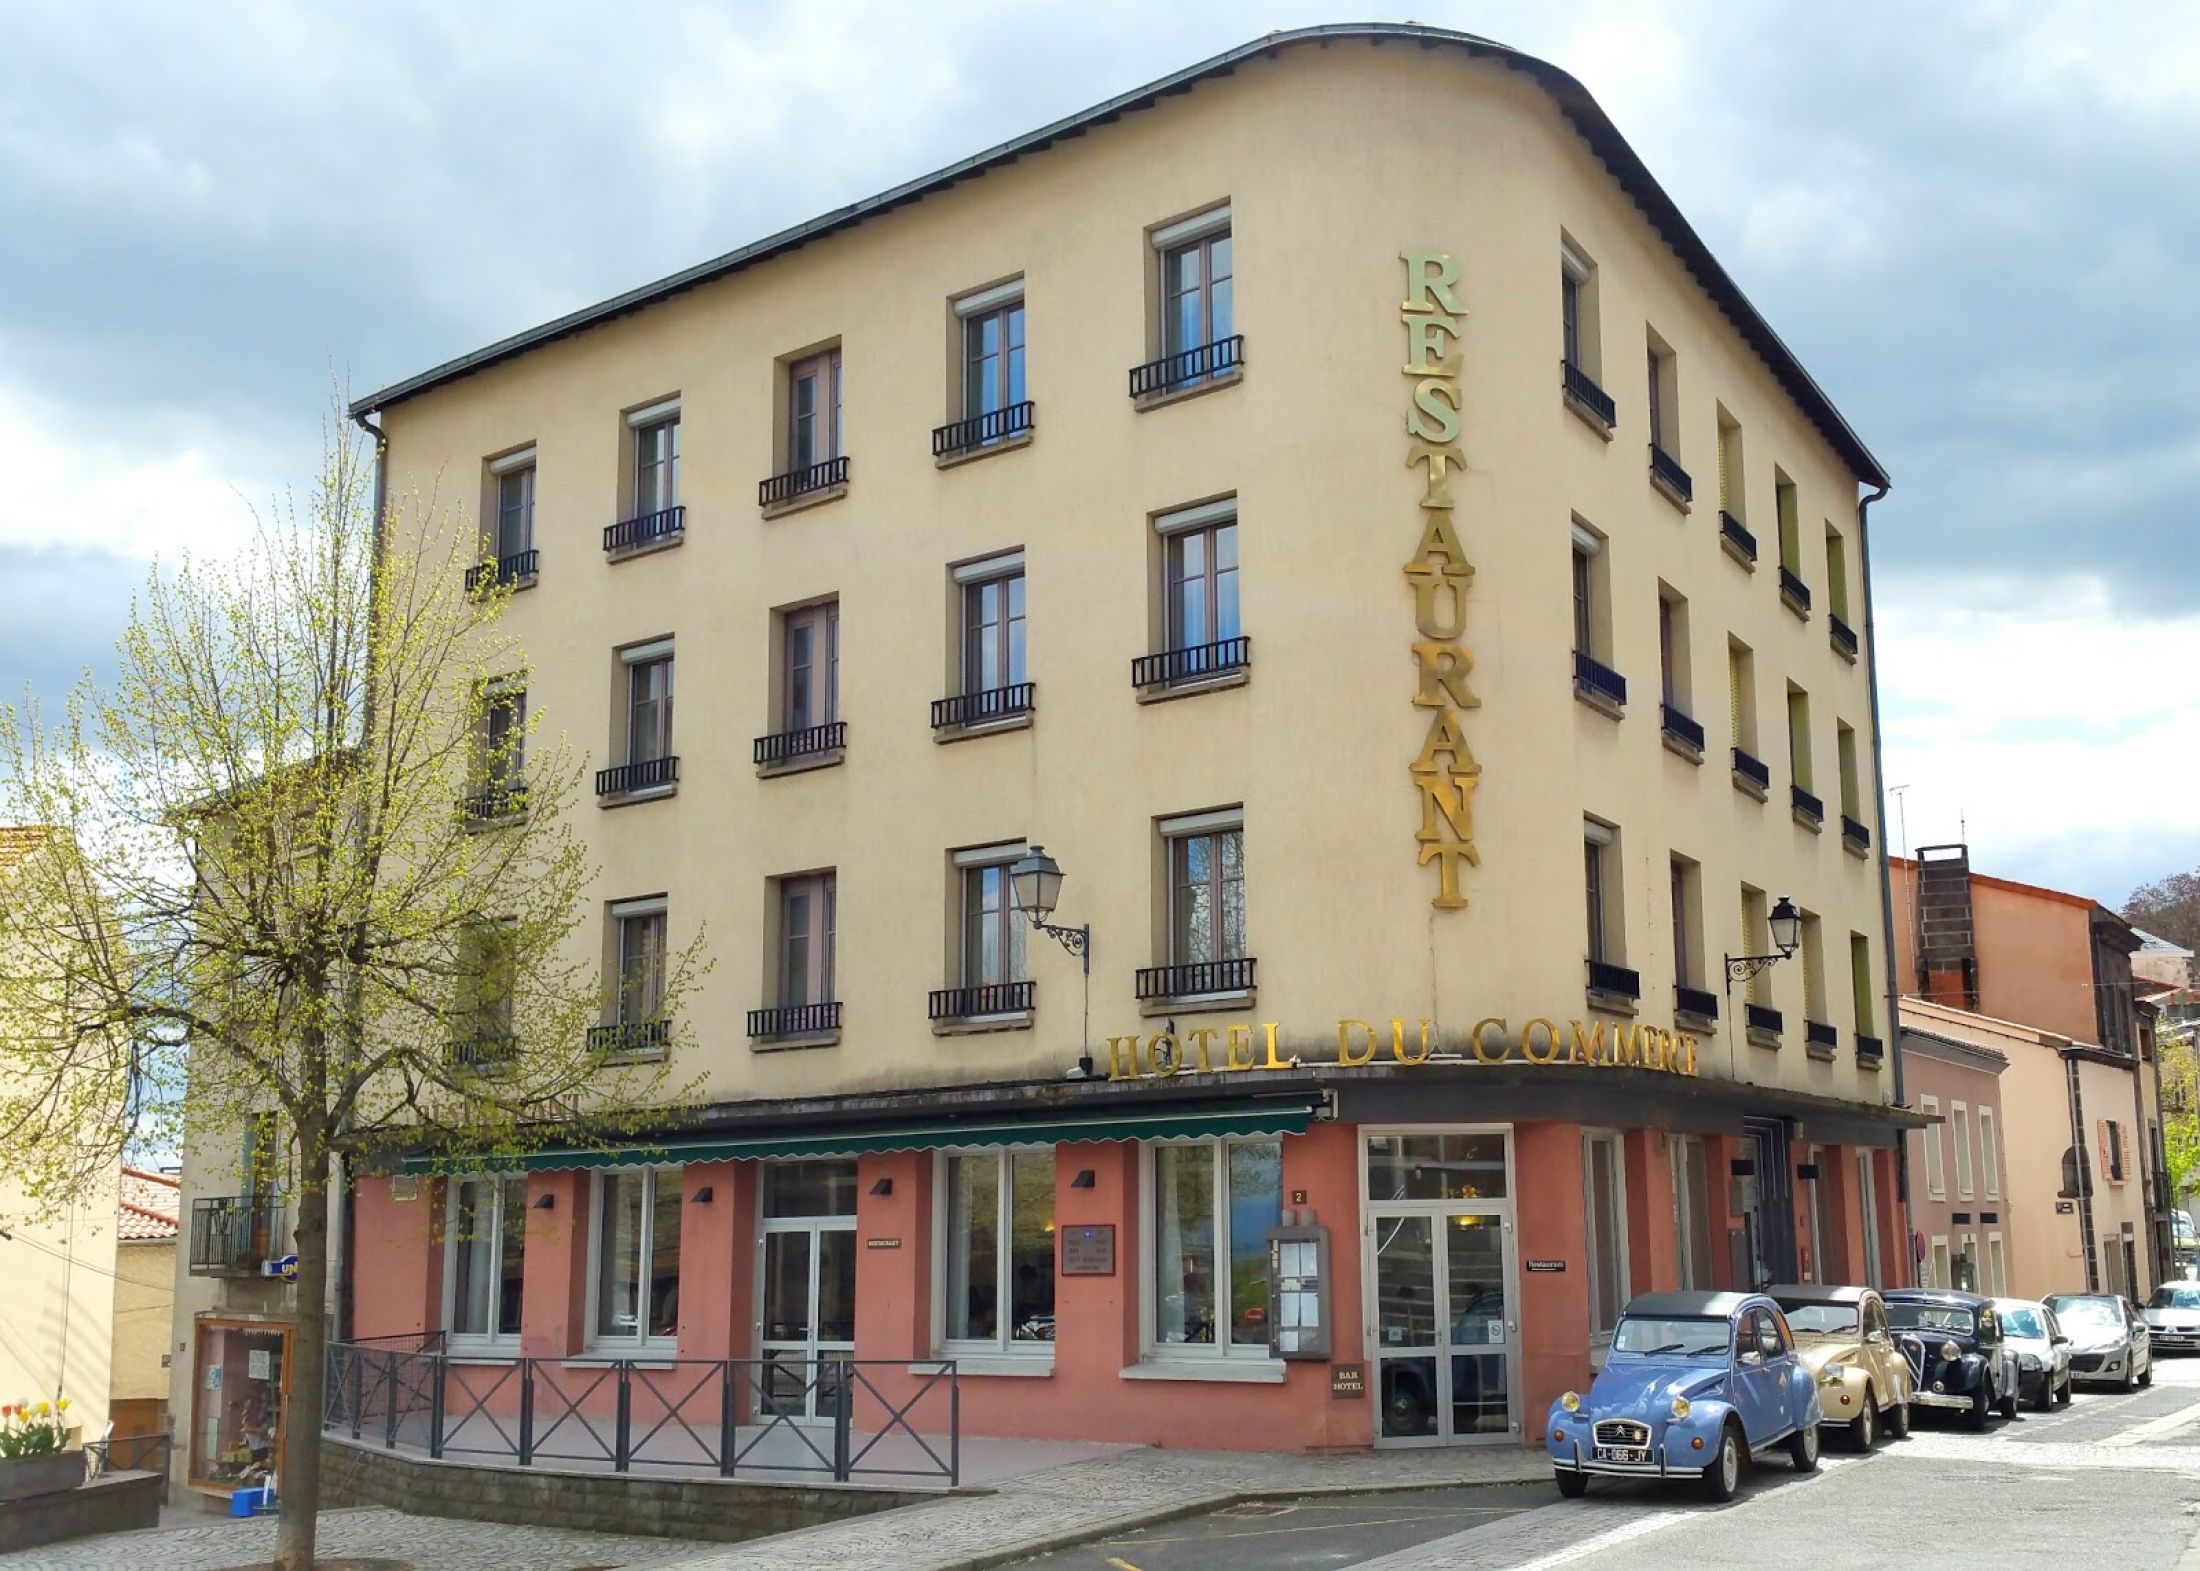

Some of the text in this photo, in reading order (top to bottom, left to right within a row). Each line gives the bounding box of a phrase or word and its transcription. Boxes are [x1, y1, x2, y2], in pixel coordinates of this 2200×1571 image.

[1399, 250, 1482, 908] RESTAURANT
[1337, 1017, 1430, 1066] DU
[1333, 1382, 1364, 1391] HOTEL
[1338, 1371, 1358, 1380] BAR
